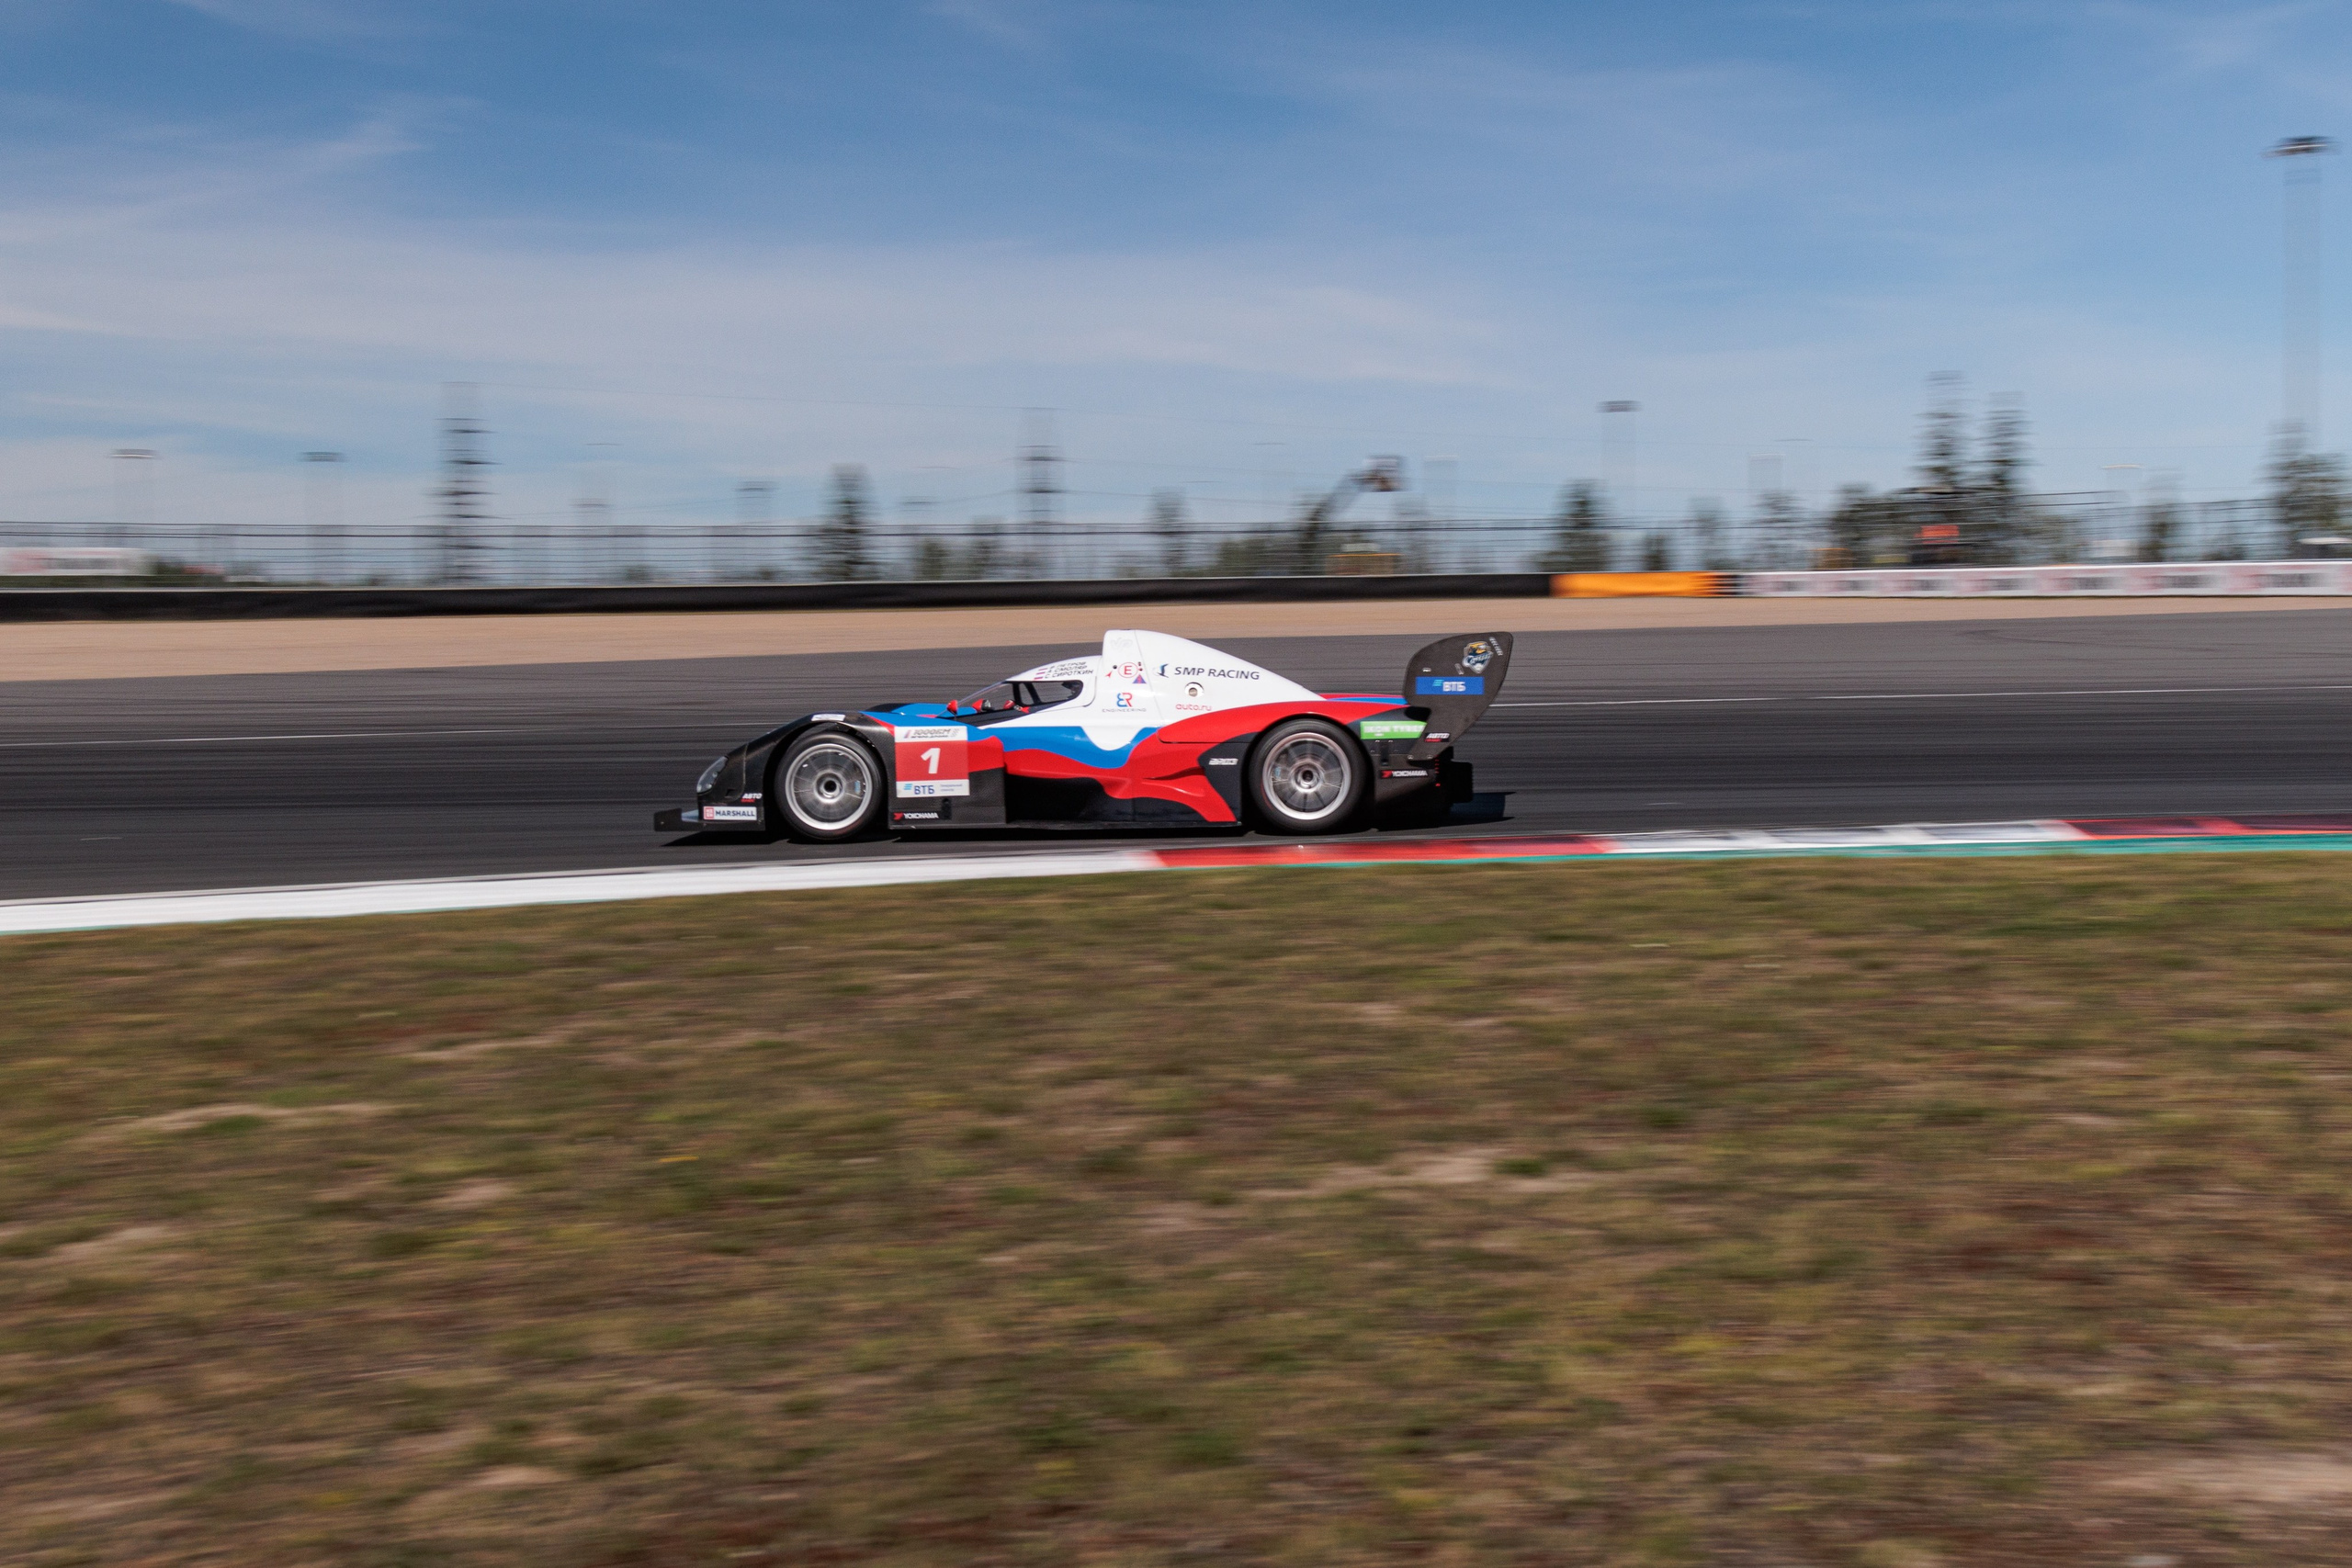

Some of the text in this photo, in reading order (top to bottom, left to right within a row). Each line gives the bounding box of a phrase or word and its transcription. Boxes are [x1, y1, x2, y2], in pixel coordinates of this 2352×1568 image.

[1052, 670, 1093, 678] СИРОТКИН
[1174, 666, 1260, 680] SMP RACING
[1442, 681, 1466, 692] ВТБ
[1175, 704, 1212, 712] auto.ru
[921, 747, 941, 774] 1
[913, 784, 935, 795] ВТБ
